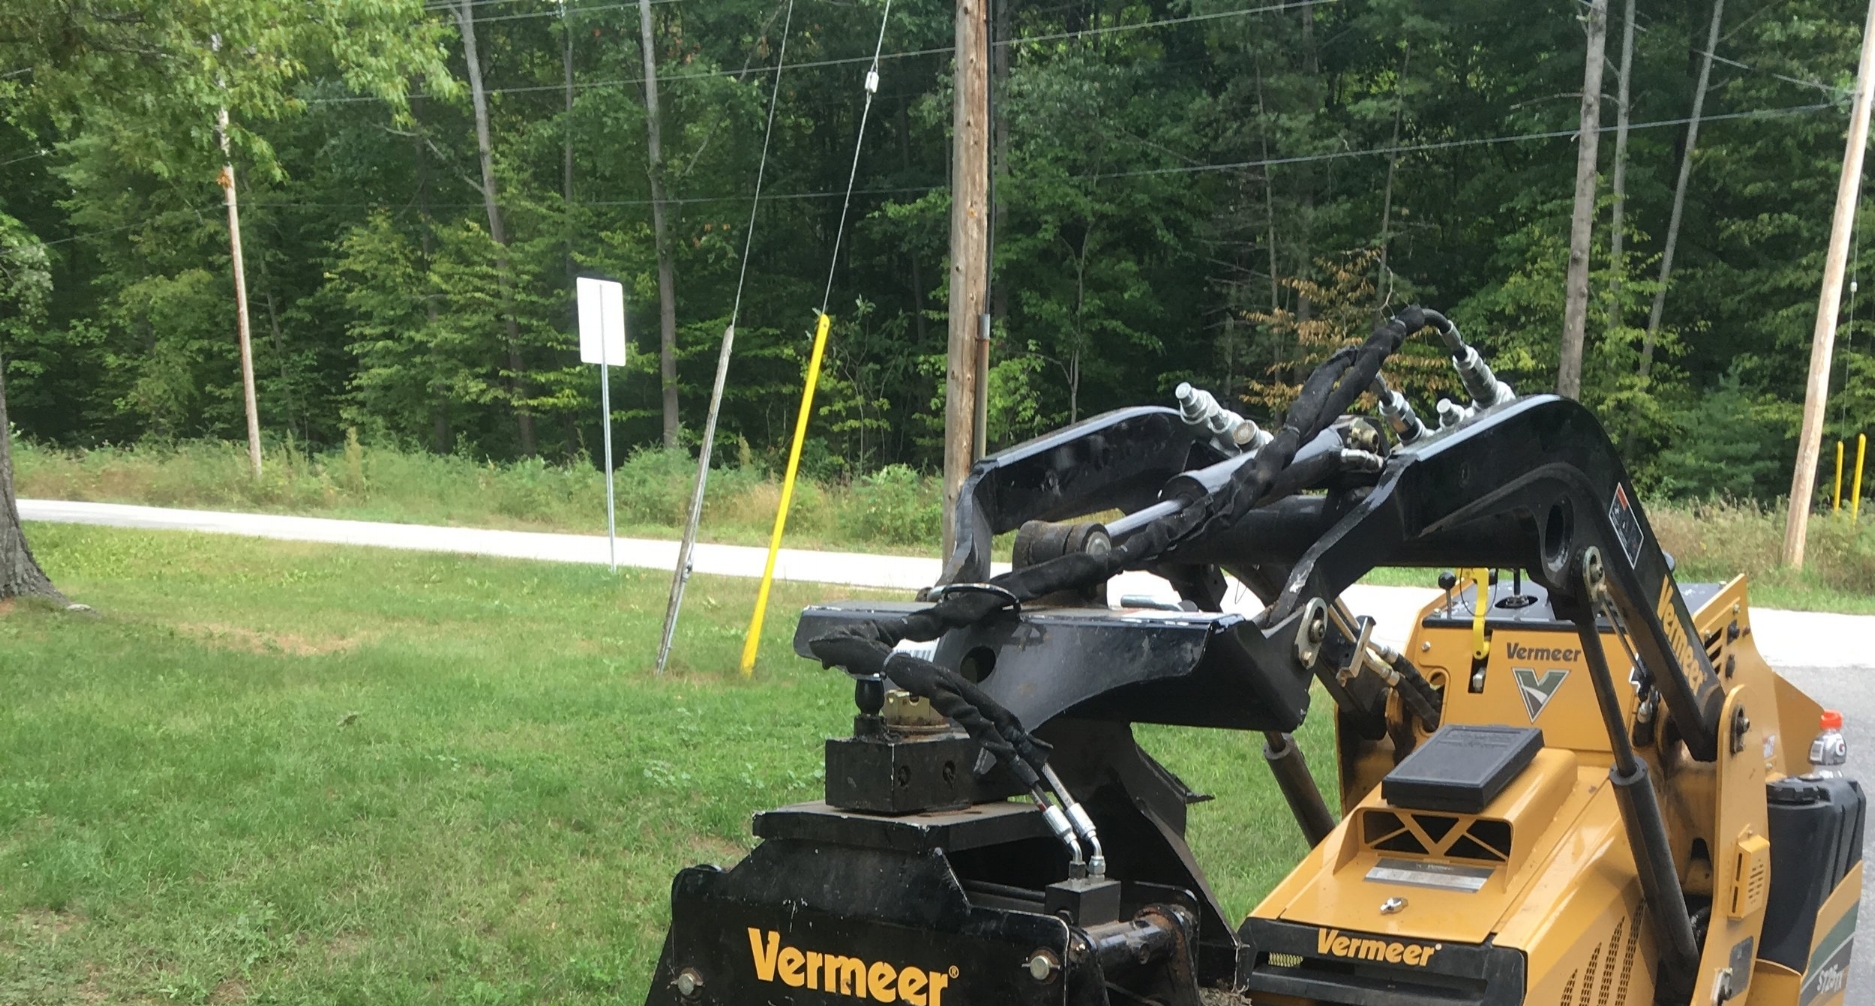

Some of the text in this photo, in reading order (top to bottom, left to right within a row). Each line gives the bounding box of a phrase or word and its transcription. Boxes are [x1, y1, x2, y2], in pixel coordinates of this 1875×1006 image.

[1507, 642, 1582, 662] Vermeer
[1656, 573, 1706, 696] Vermeer
[1317, 927, 1437, 967] Vermeer
